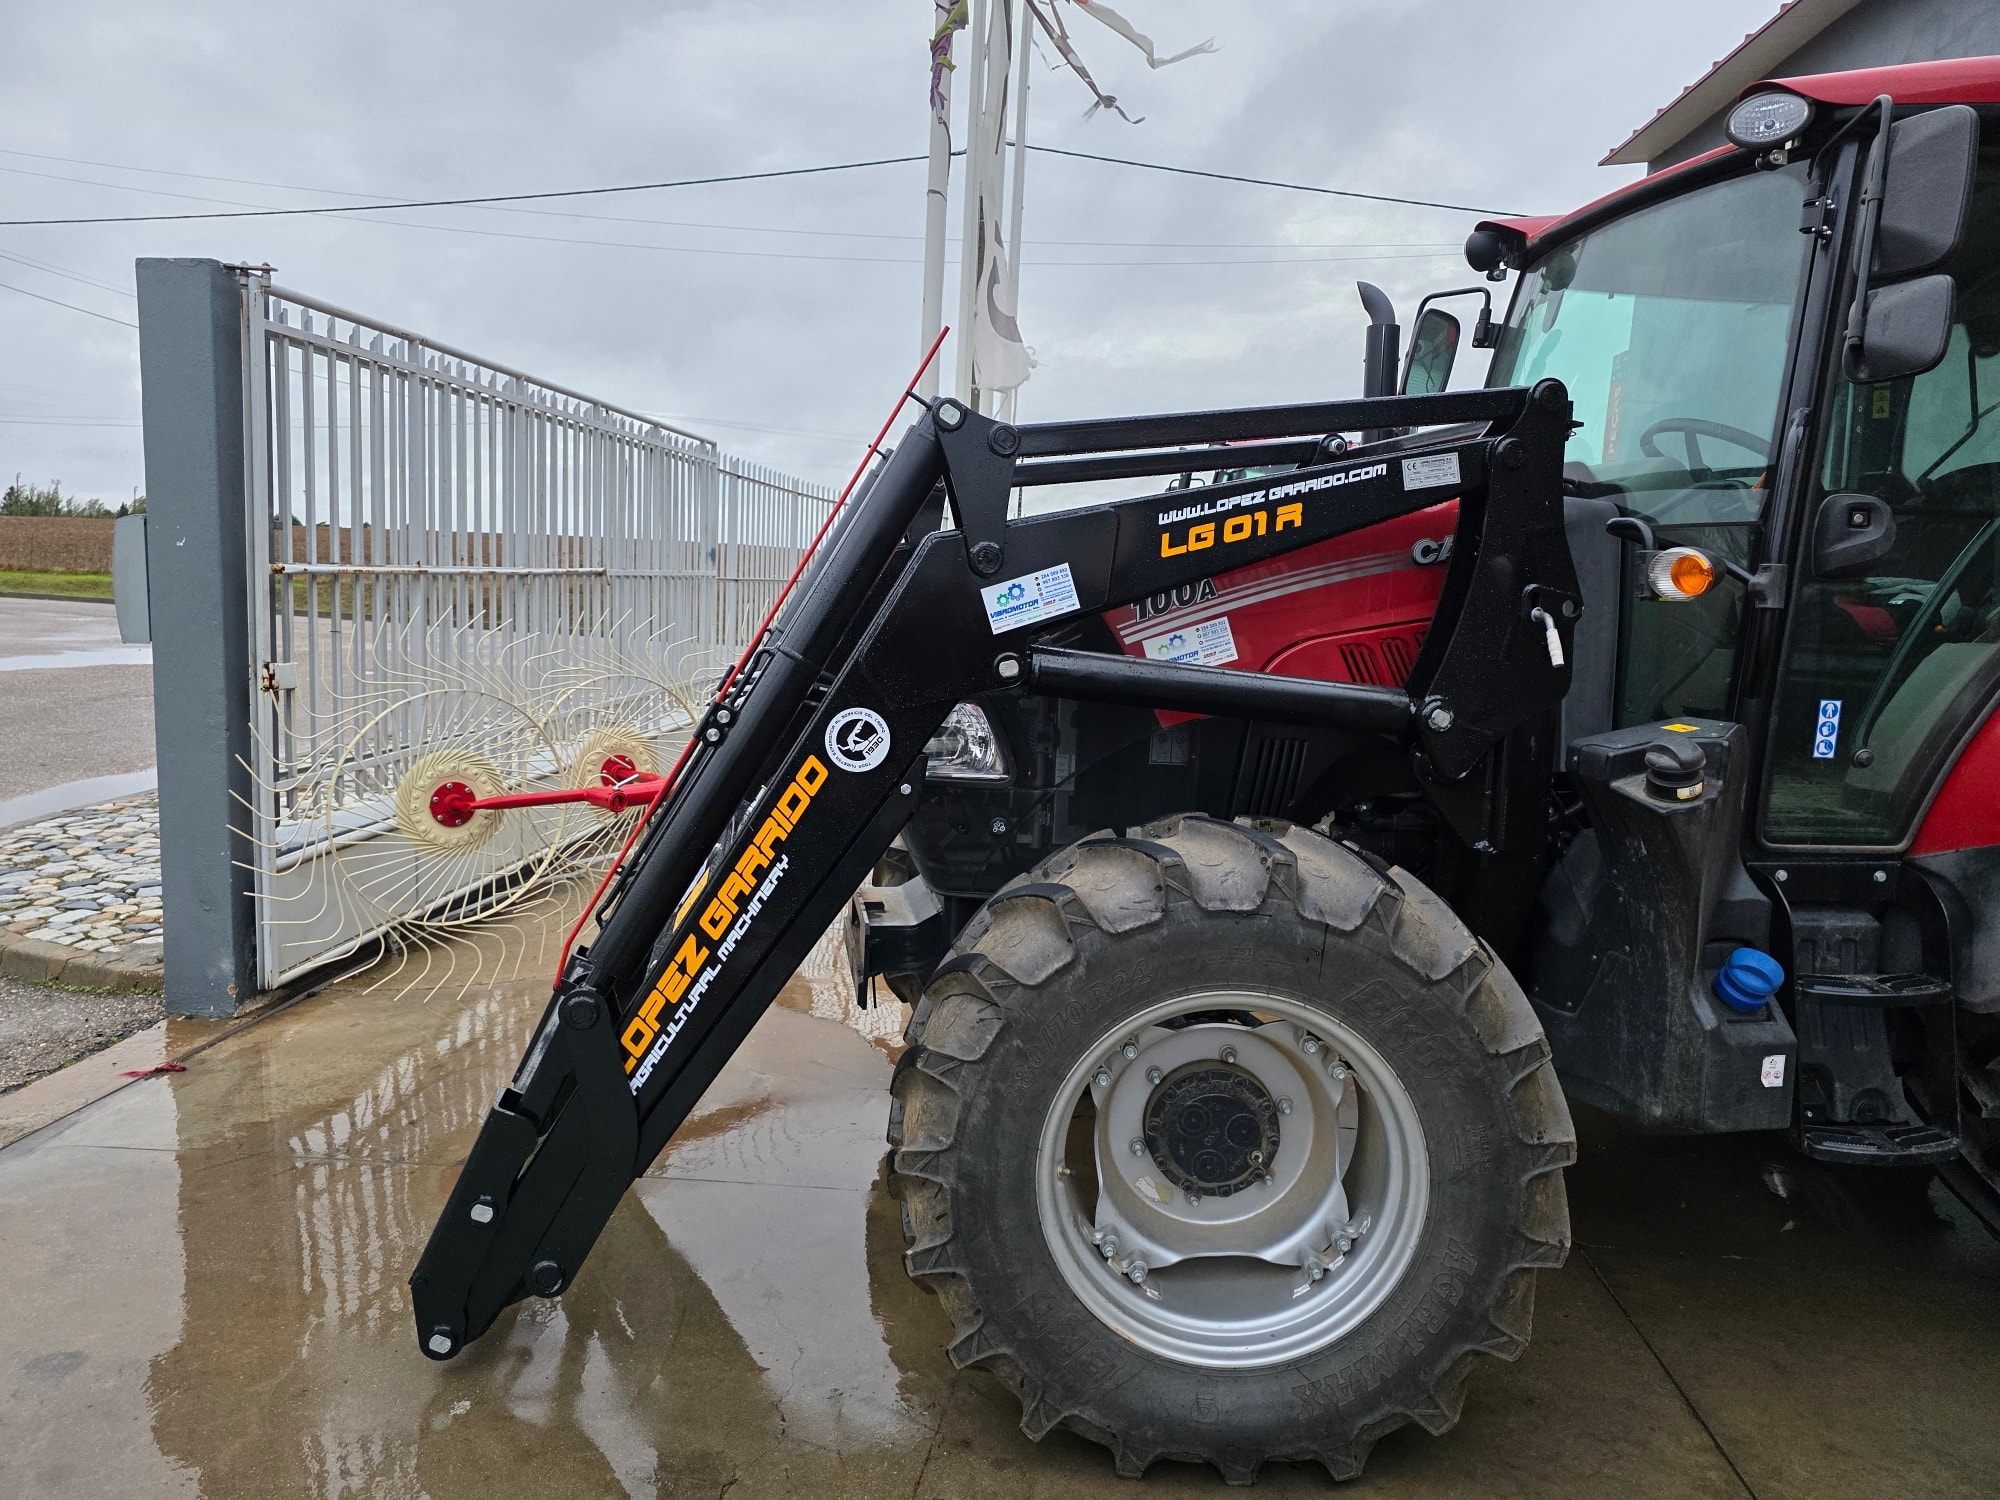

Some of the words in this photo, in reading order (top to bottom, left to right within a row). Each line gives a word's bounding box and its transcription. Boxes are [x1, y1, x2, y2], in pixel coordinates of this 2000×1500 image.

[1269, 463, 1387, 501] GARRIDO.COM
[1161, 522, 1215, 558] LG
[1276, 502, 1303, 532] R
[990, 599, 1039, 619] VIBROMOTOR
[1130, 577, 1219, 622] 100A
[865, 736, 884, 755] 1930
[699, 754, 829, 941] GARRIDO
[629, 964, 721, 1096] AGRICULTURAL
[718, 854, 789, 961] MACHINERY
